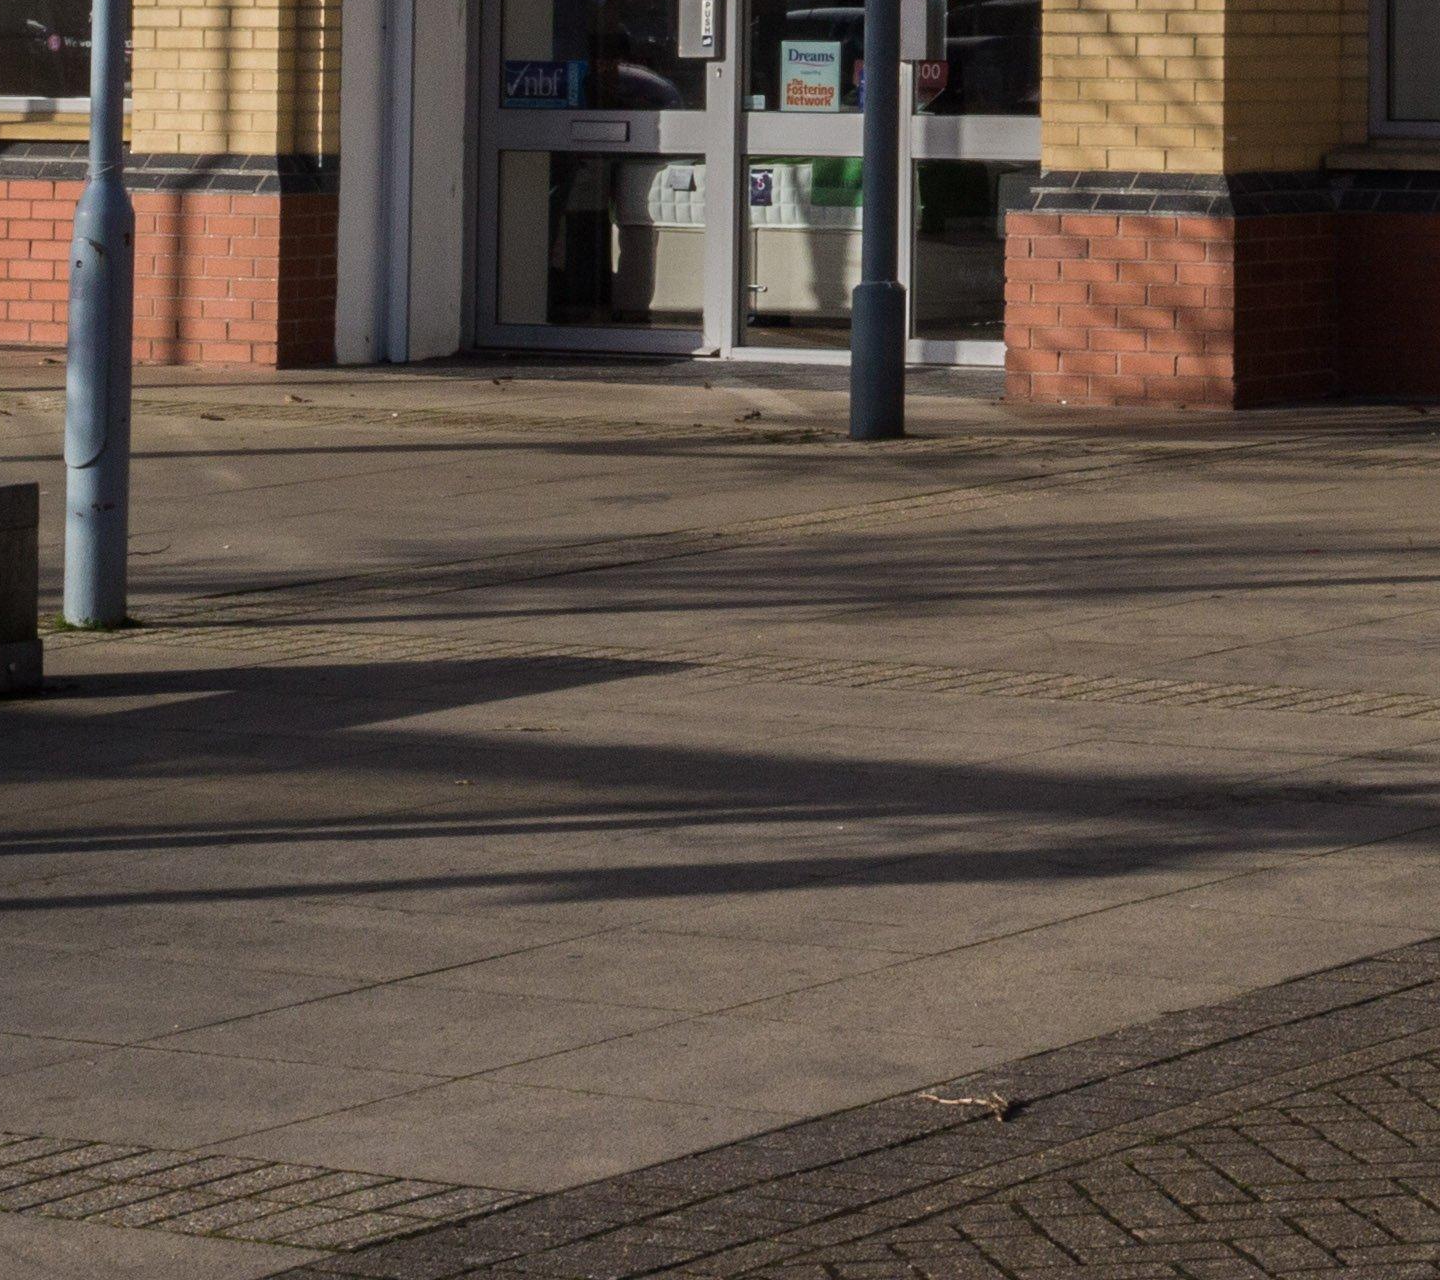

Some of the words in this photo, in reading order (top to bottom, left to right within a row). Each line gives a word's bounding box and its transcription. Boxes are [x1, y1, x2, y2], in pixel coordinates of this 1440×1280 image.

[788, 48, 836, 63] Dreams
[523, 67, 564, 96] nbf
[786, 83, 835, 98] Fostering
[786, 95, 832, 107] Network
